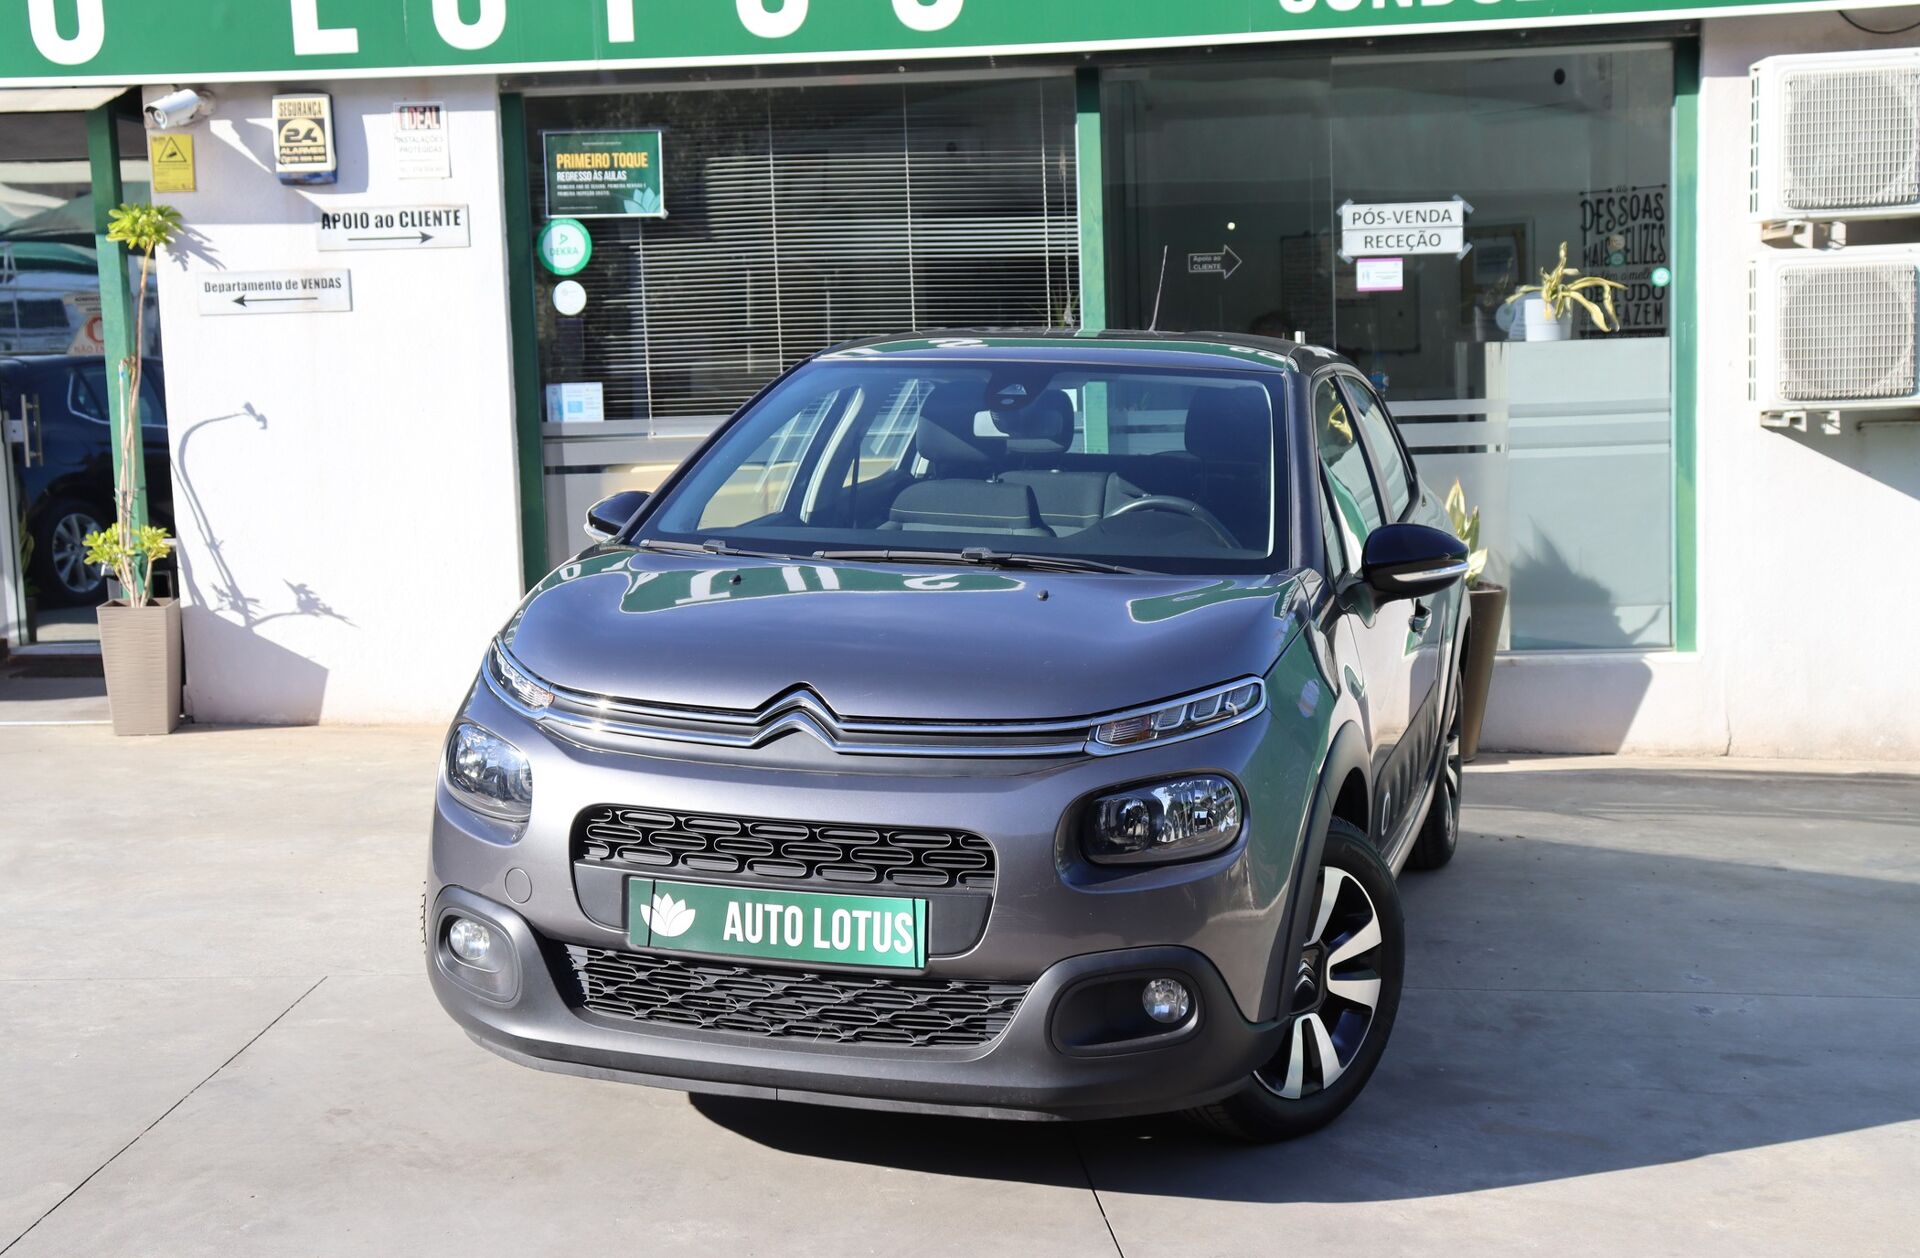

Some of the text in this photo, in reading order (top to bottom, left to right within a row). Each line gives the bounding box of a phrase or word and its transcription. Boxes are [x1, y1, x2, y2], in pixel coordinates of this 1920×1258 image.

[279, 101, 323, 119] SEGURANÇA
[401, 106, 441, 129] IDEAL
[284, 128, 318, 144] 24
[280, 146, 326, 155] ALARMES
[556, 152, 649, 170] PRIMEIRO TOQUE
[556, 169, 627, 182] REGRESSO ÀS AULAS
[321, 208, 462, 230] APOIO ao CLIENTE
[1352, 208, 1452, 226] PÓS-VENDA
[1579, 192, 1666, 247] PESSOAS
[1364, 230, 1442, 251] RECEÇÃO
[1617, 223, 1667, 266] ELIZES
[549, 247, 579, 257] DEKRA
[204, 277, 342, 294] Departamento de VENDAS
[723, 901, 914, 955] AUTO LOTUS
